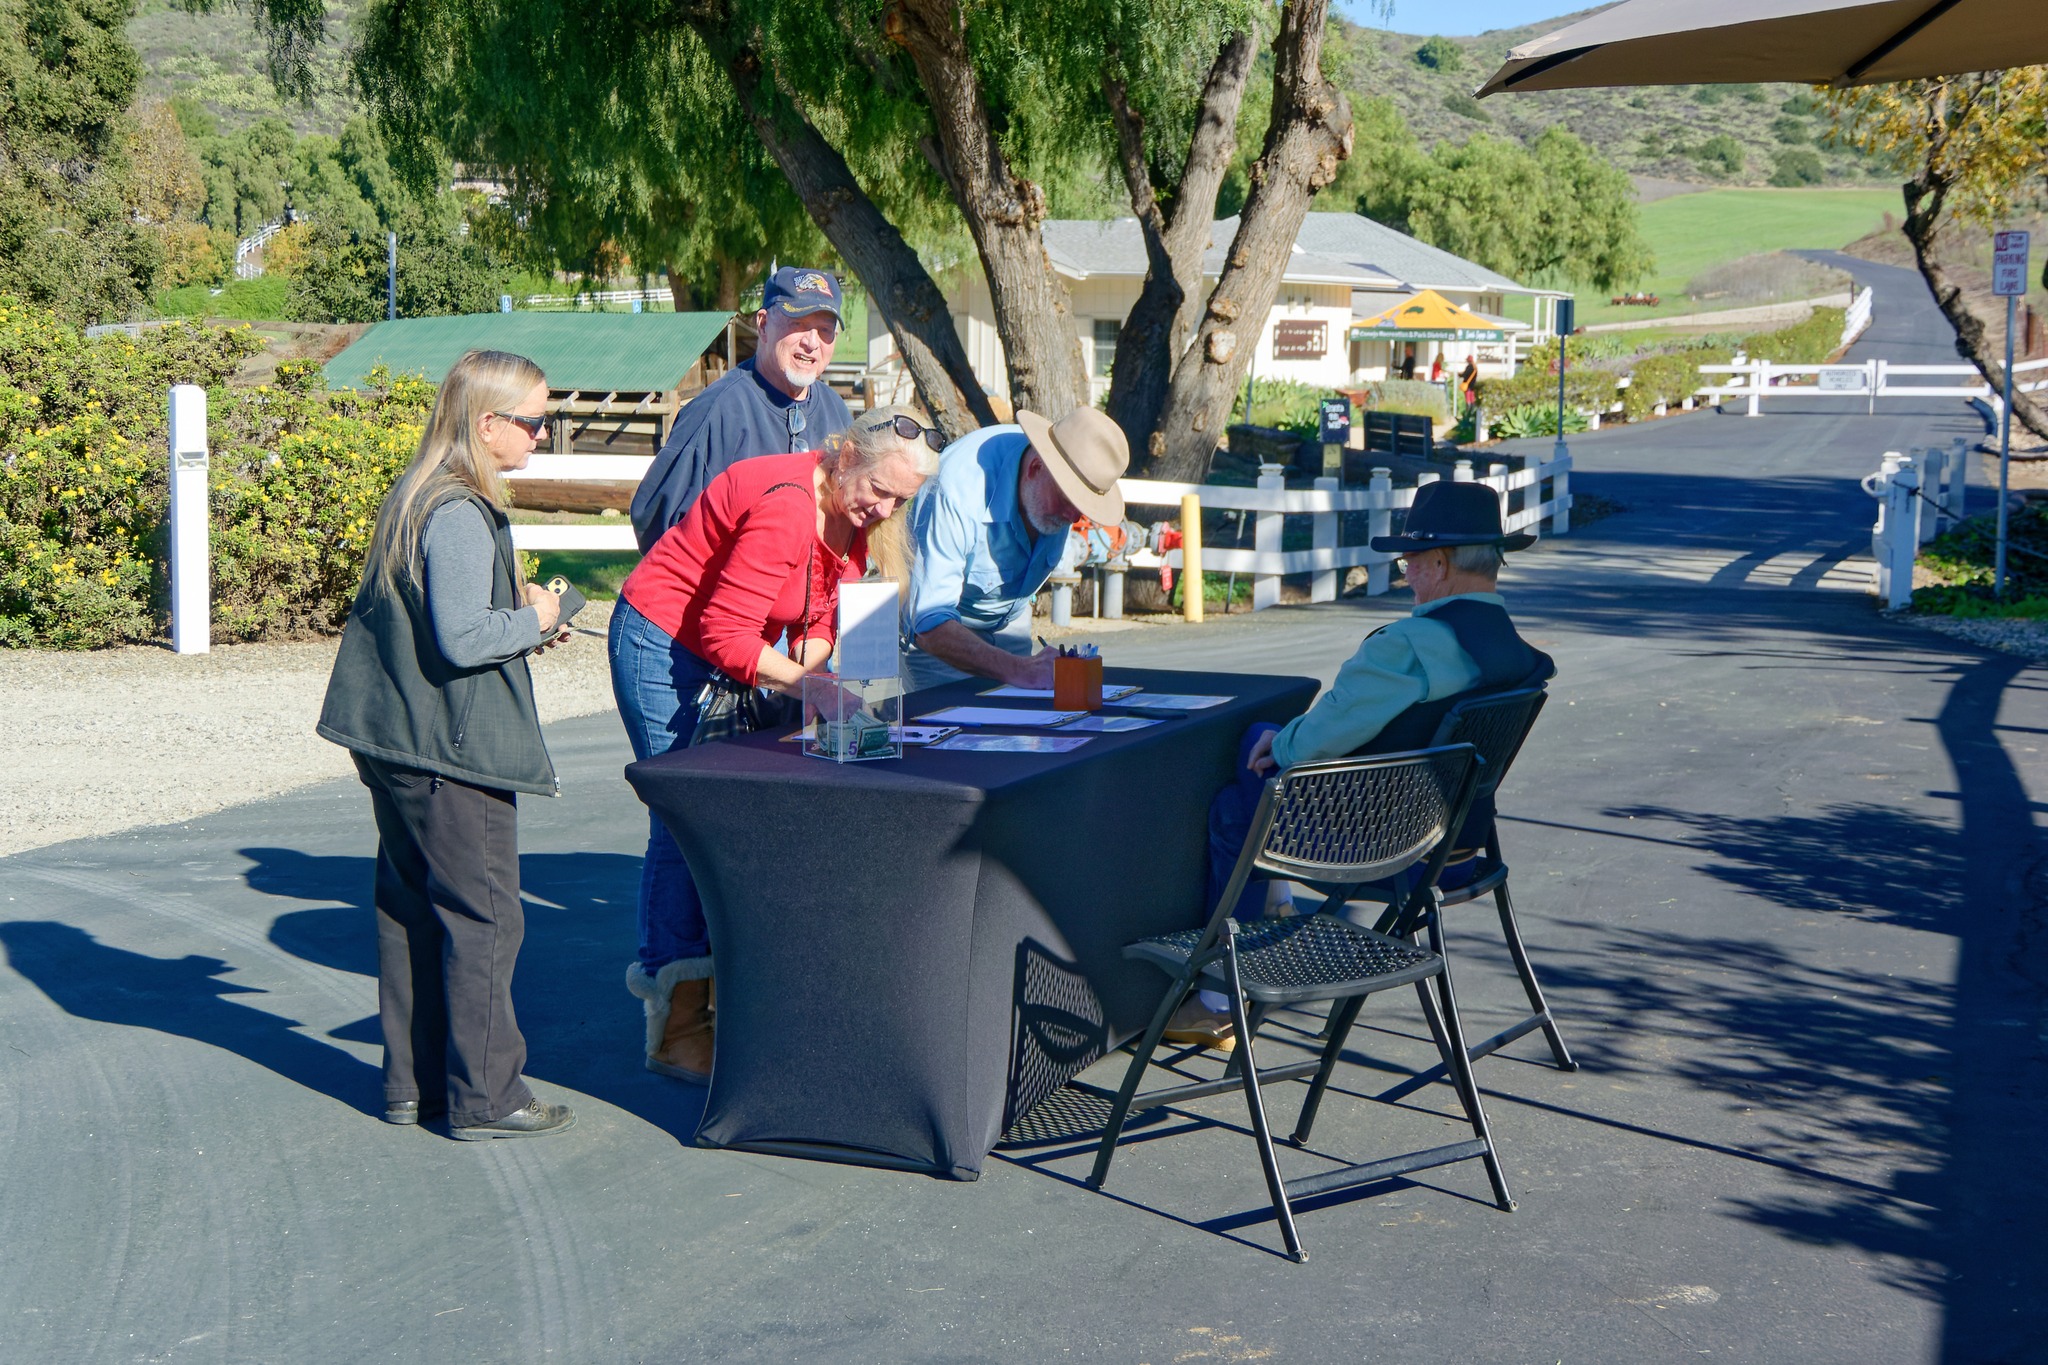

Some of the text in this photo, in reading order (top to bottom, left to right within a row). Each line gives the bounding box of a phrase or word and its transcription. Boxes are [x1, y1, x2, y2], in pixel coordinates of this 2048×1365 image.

[1996, 253, 2025, 265] PARKING
[2002, 268, 2018, 278] FIRE
[848, 741, 857, 755] 5
